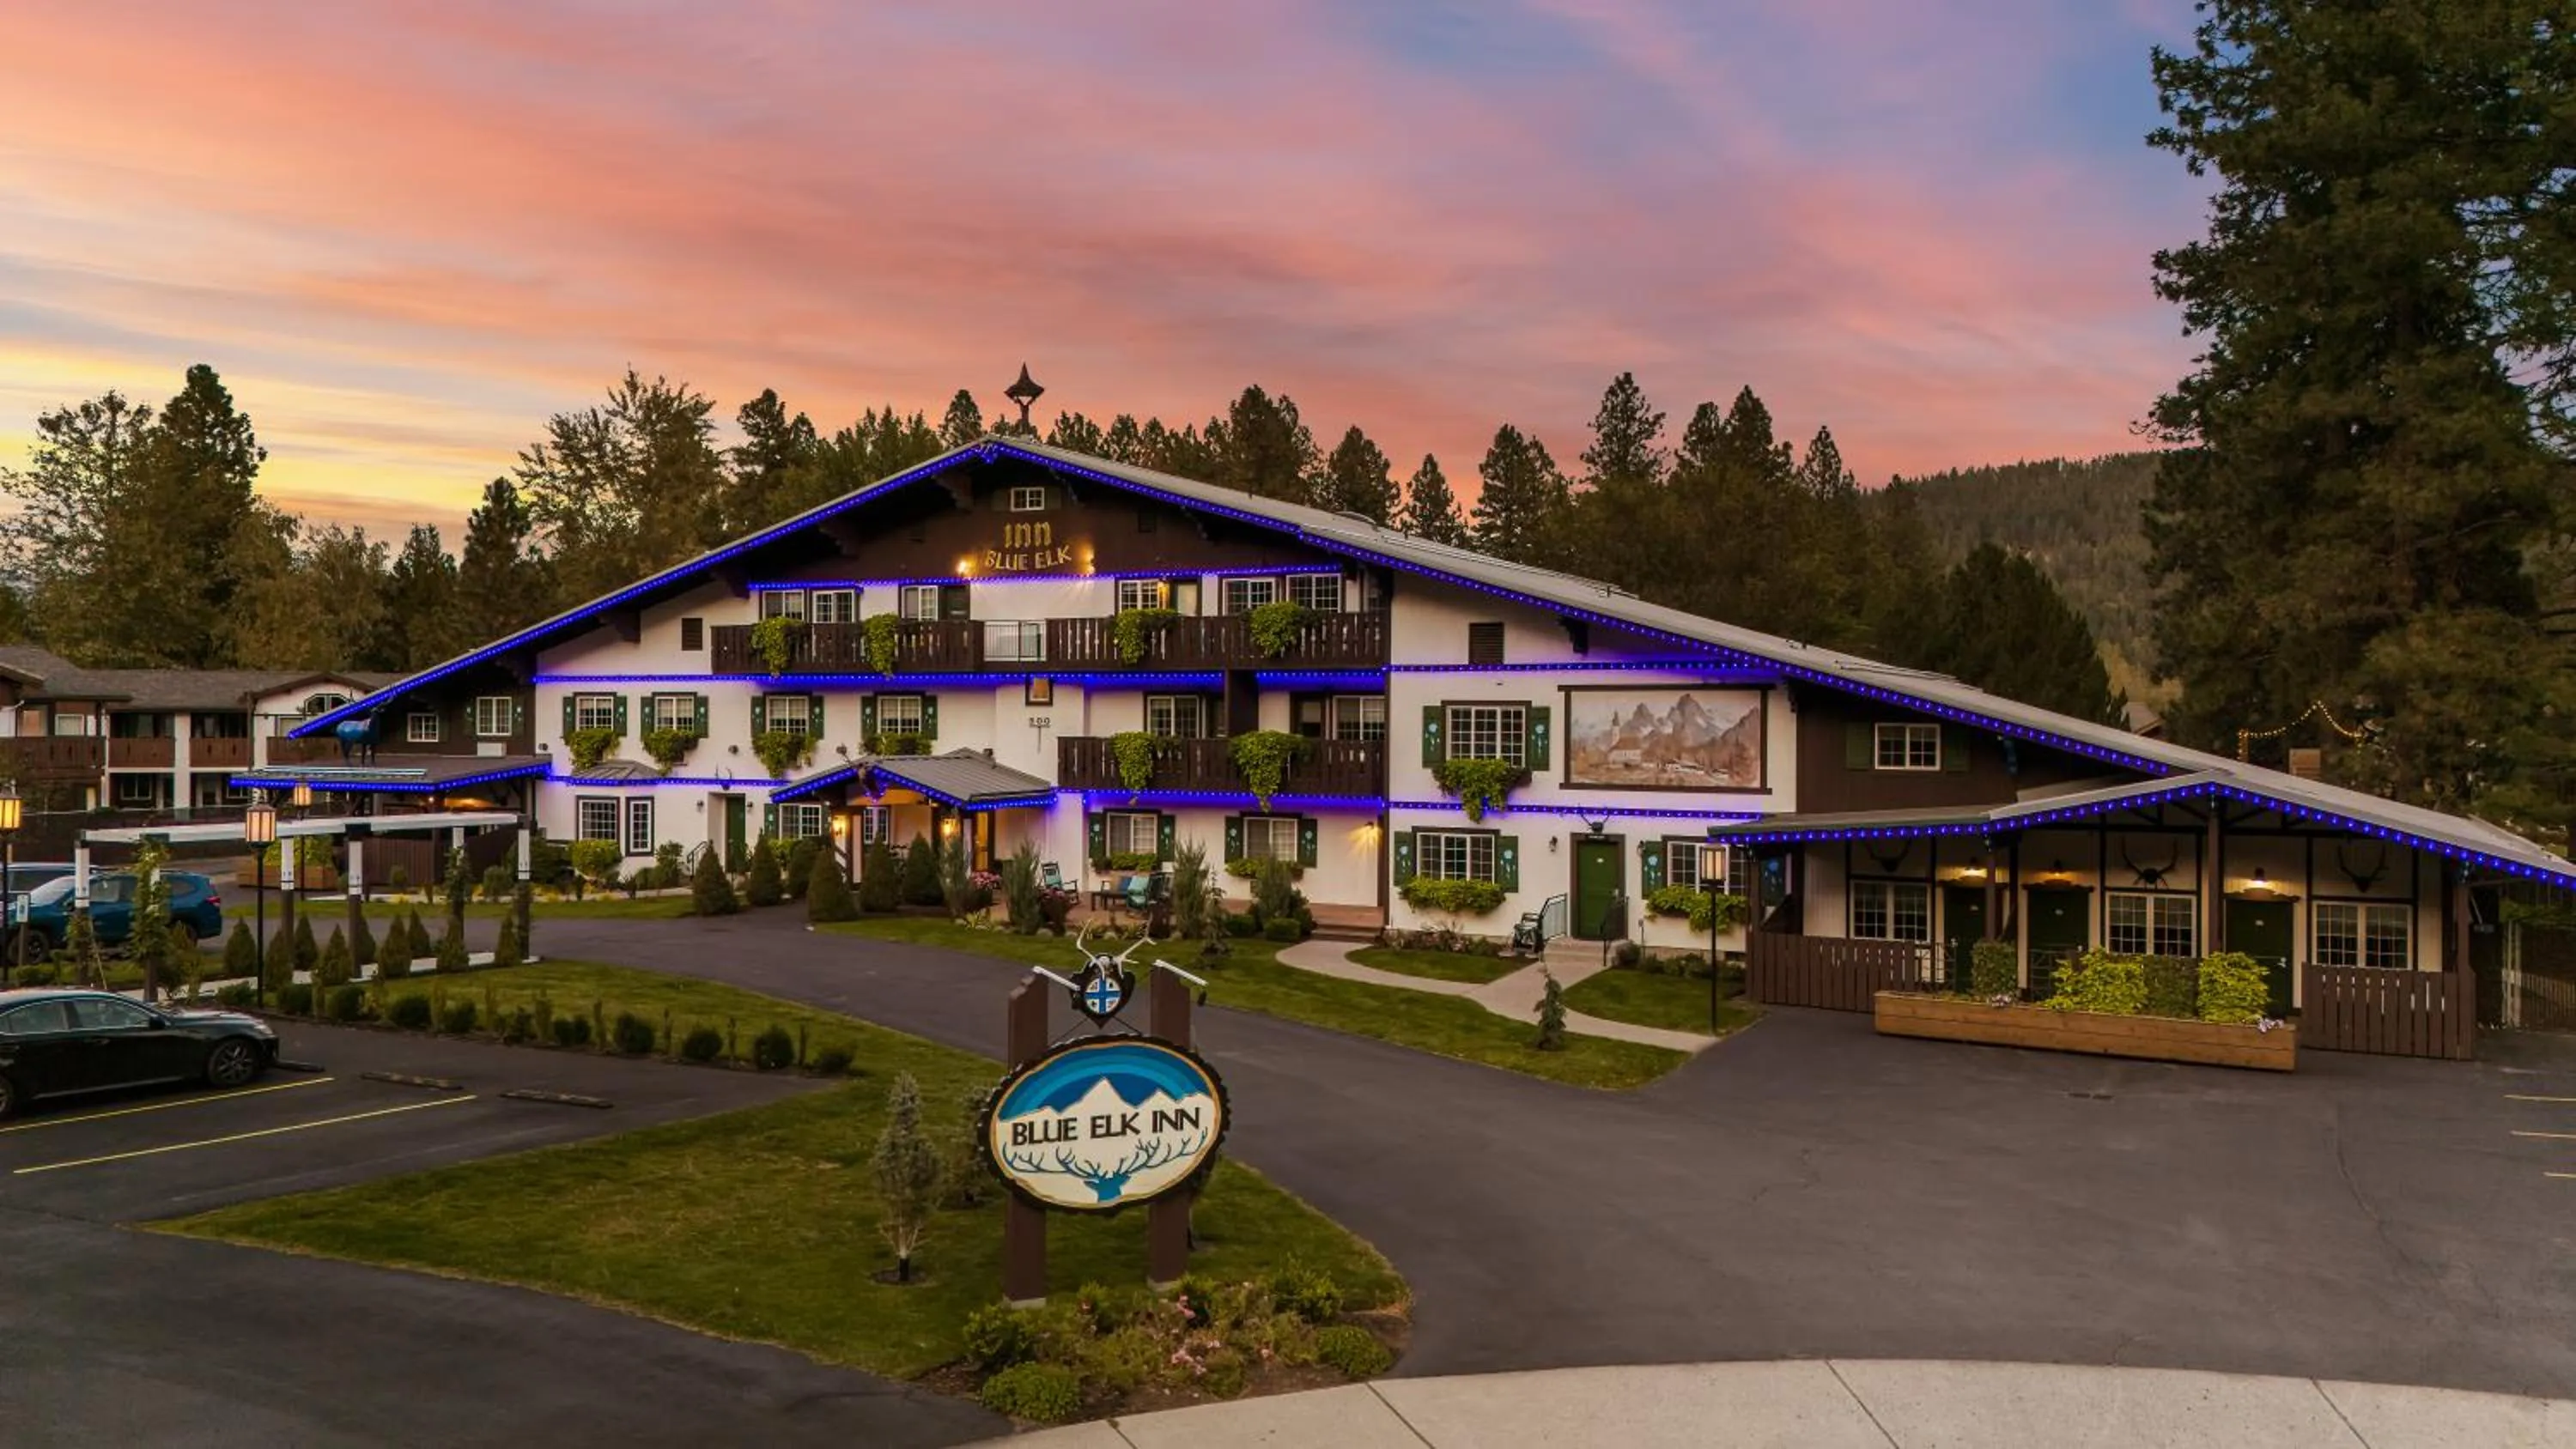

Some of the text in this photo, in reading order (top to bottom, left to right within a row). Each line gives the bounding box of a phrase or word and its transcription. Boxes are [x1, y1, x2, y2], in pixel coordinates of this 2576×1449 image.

[985, 545, 1072, 571] BLUE ELK
[1012, 1106, 1200, 1146] BLUE ELK INN
